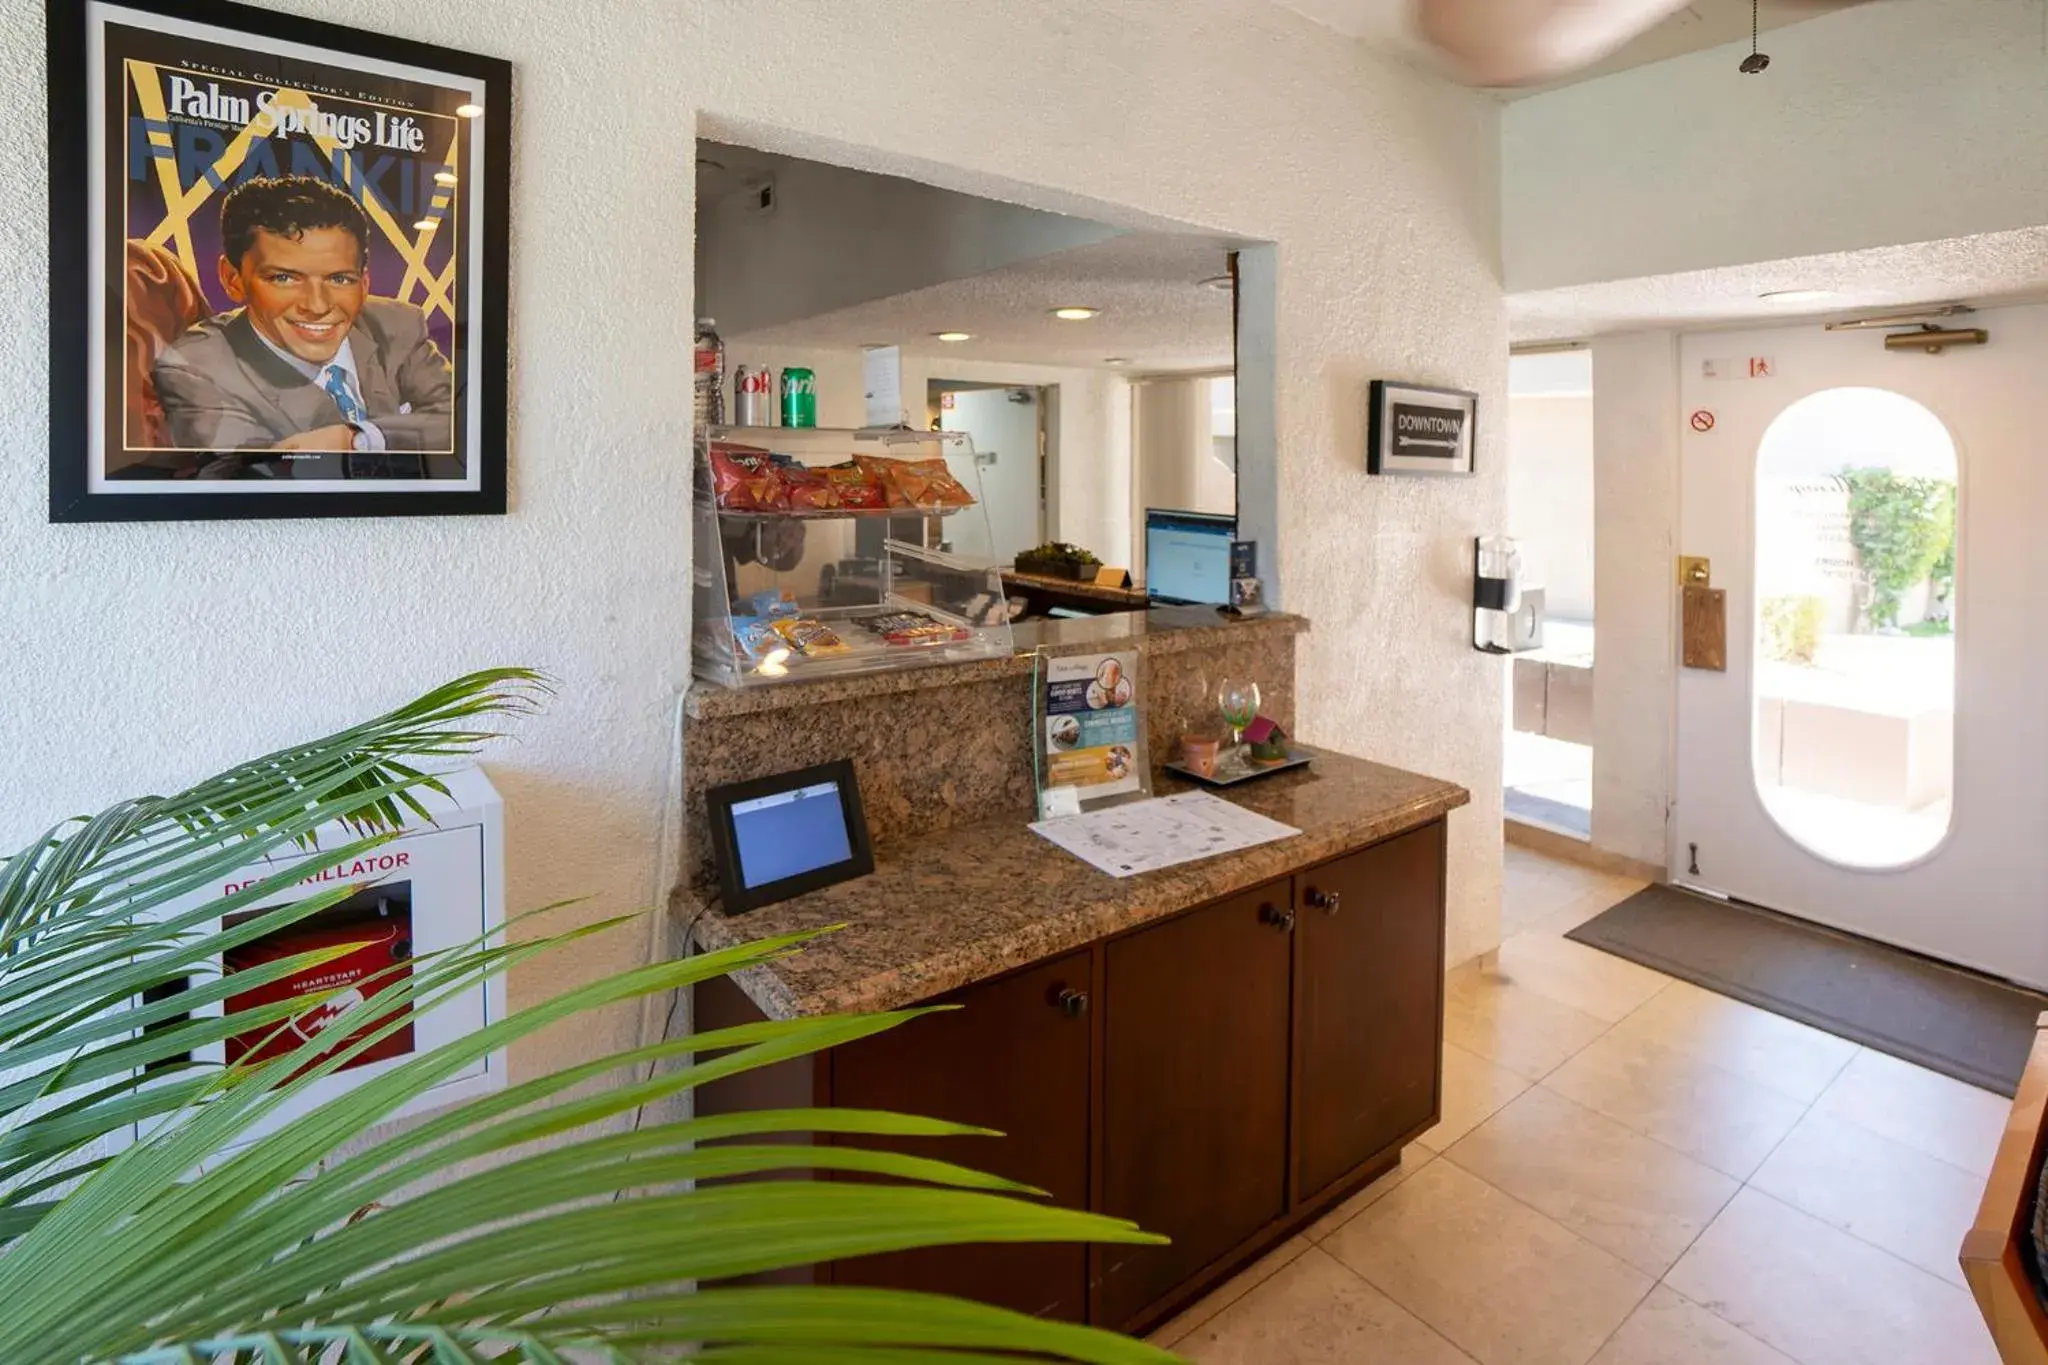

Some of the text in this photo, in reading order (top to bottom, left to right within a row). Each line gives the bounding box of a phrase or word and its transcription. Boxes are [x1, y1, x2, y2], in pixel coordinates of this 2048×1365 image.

[180, 59, 415, 108] SPECIAL COLLECTOR'S EDITION
[168, 74, 425, 153] Palm Springs Life
[129, 116, 454, 221] FRANKIE
[1398, 414, 1461, 434] DOWNTOWN
[224, 852, 410, 897] DILLATOR
[292, 968, 362, 991] HEARTSTART
